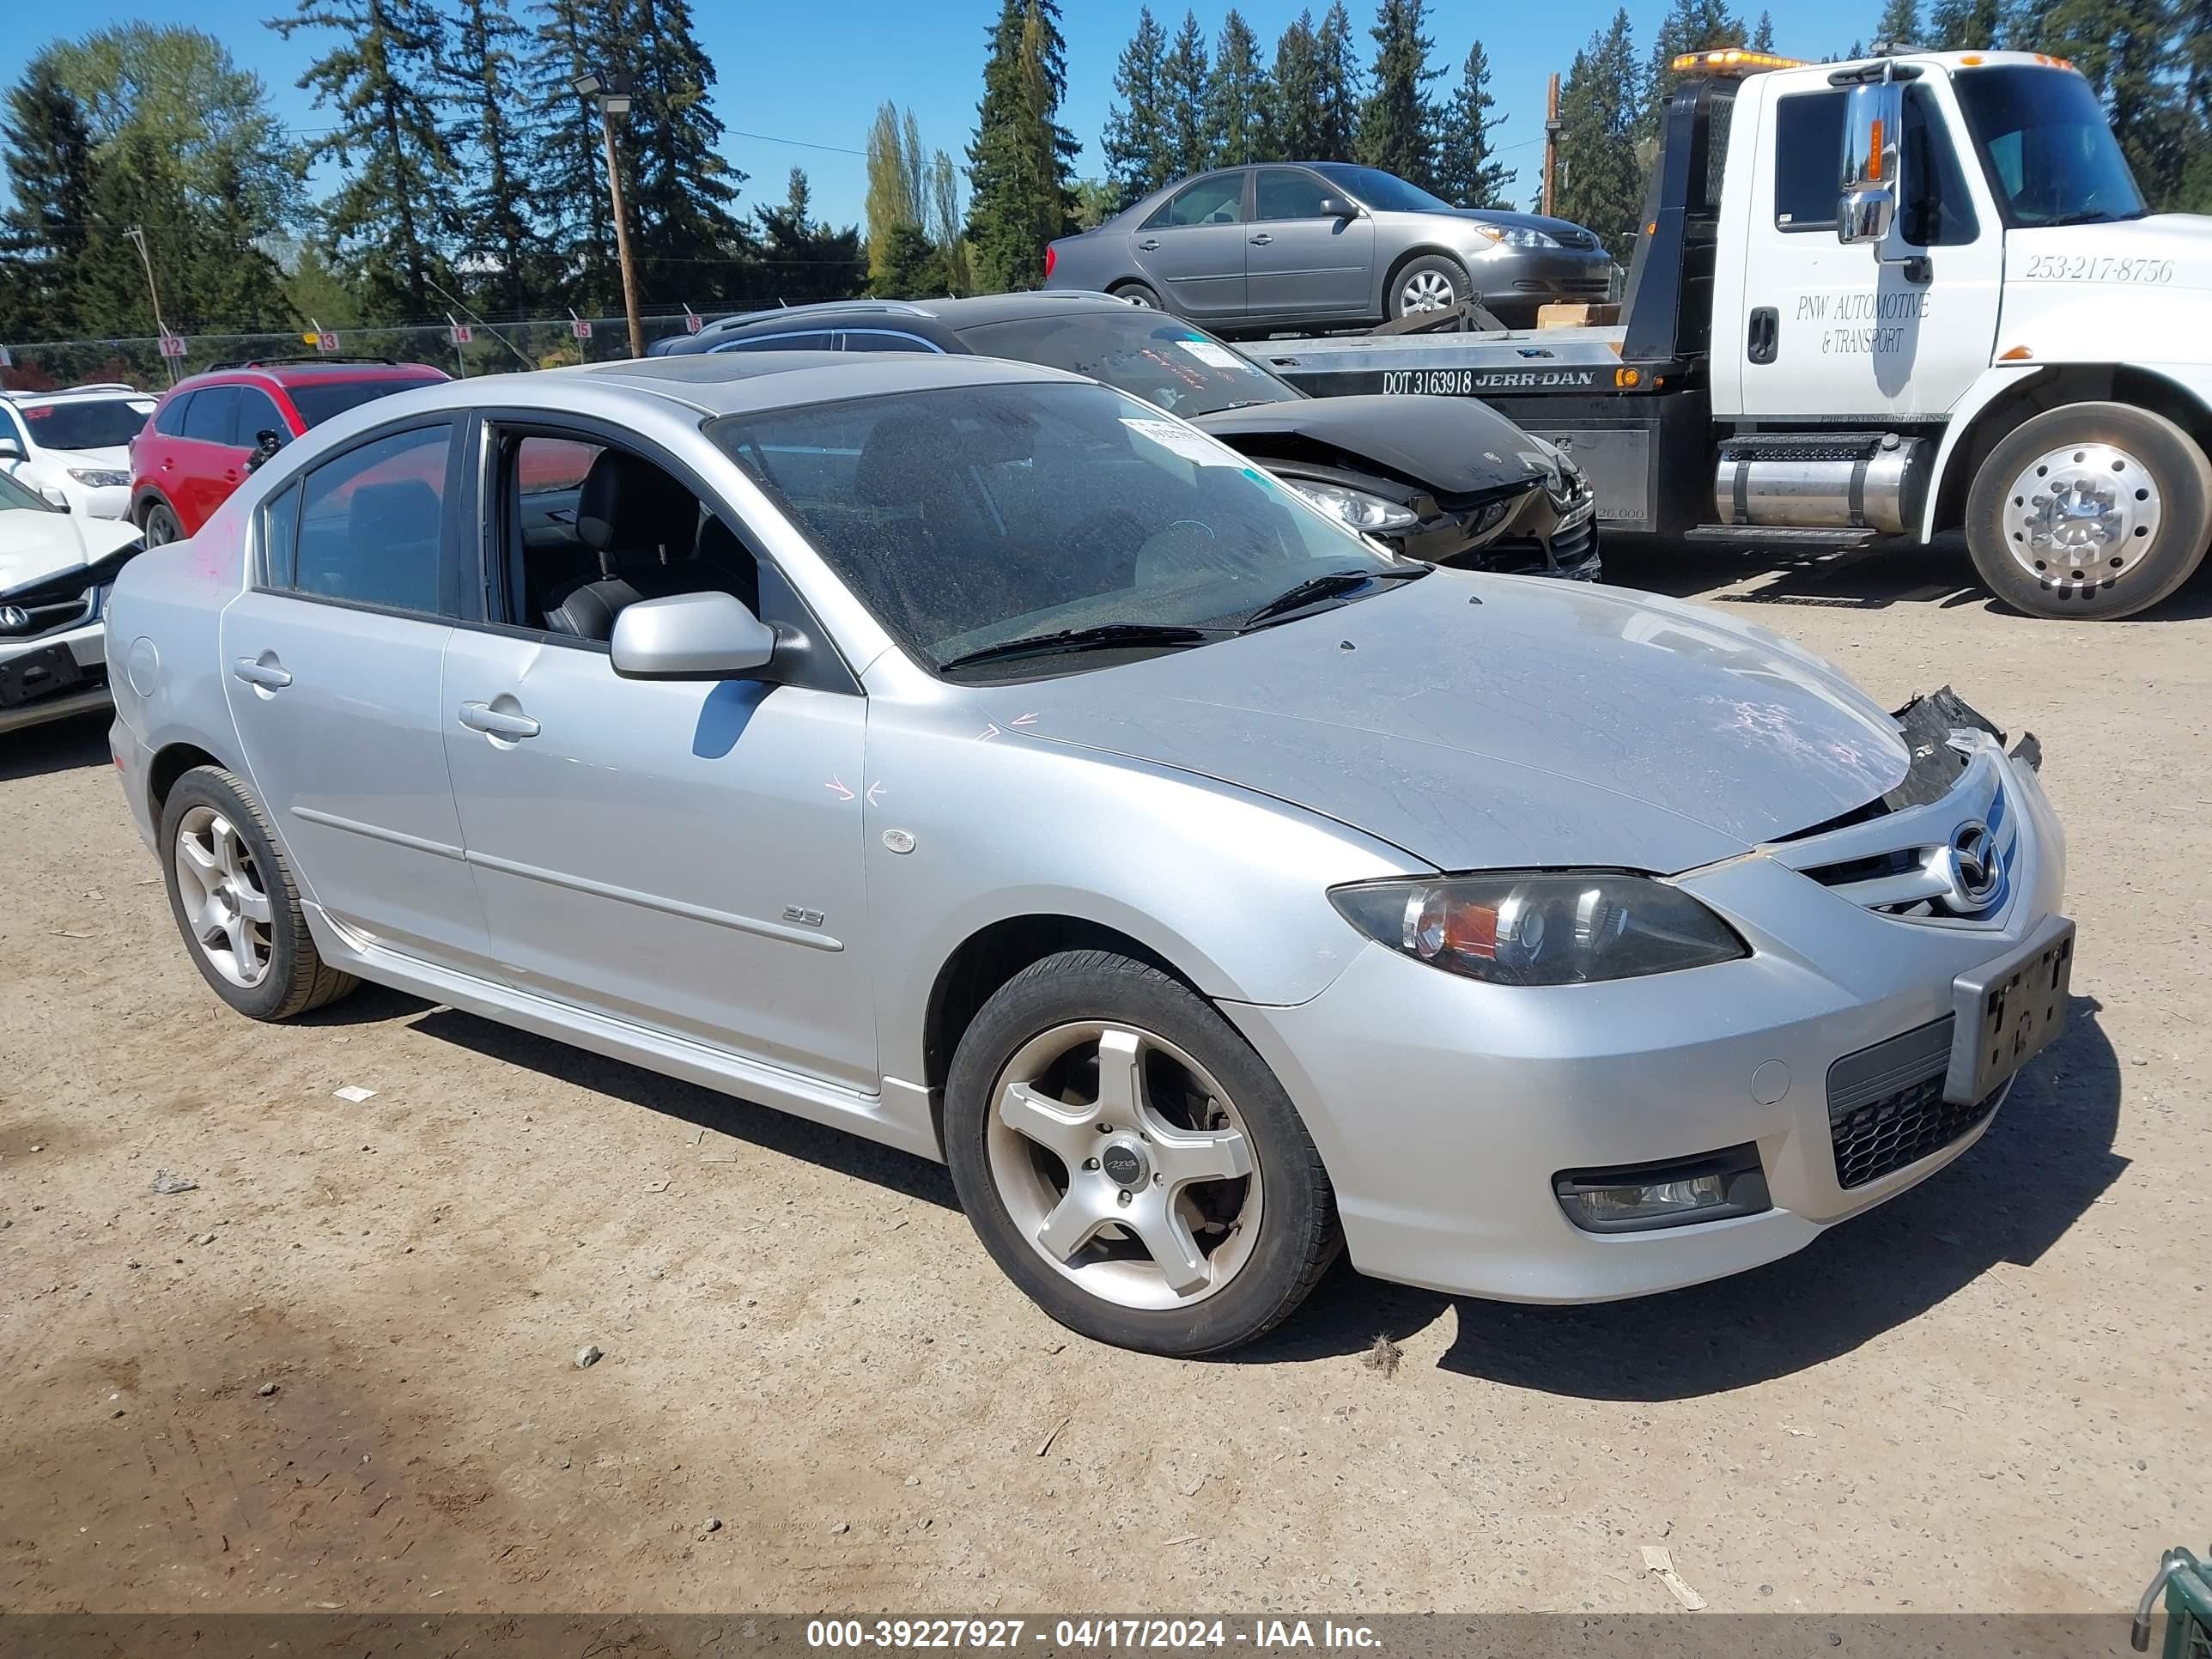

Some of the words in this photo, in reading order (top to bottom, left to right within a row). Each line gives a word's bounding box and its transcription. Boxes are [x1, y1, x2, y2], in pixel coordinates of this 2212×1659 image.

[2026, 255, 2175, 283] 253-217-8756
[1796, 295, 1830, 319] PNW
[1833, 292, 1931, 319] AUTOMOTIVE
[575, 323, 588, 337] 15
[689, 318, 701, 331] 16
[319, 333, 336, 349] 13
[455, 327, 469, 342] 14
[1821, 331, 1831, 354] &
[1834, 327, 1905, 353] TRANSPORT
[163, 338, 183, 355] 12
[1382, 371, 1413, 394] DOT
[1414, 371, 1472, 394] 3163918
[1475, 371, 1596, 386] JERR-DAN
